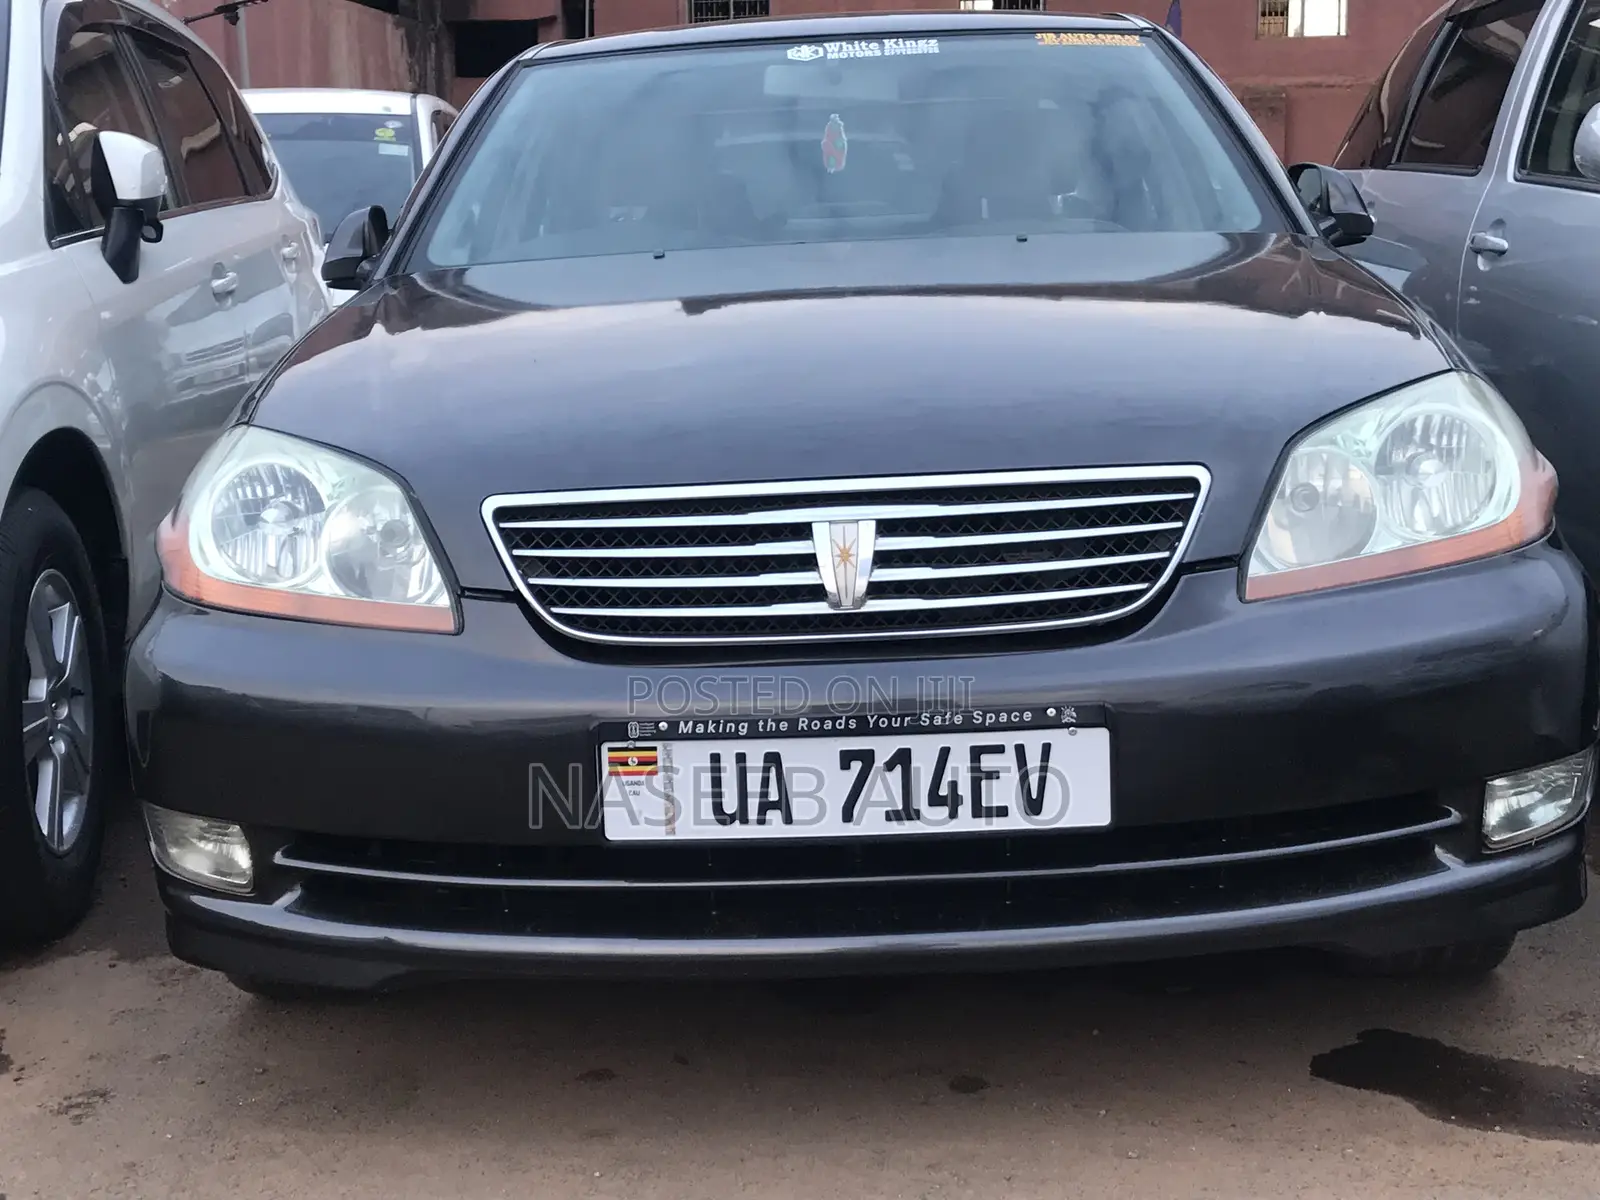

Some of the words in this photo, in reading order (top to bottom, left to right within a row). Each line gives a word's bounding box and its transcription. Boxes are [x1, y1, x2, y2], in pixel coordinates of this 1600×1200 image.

[823, 40, 880, 53] White
[883, 38, 939, 50] Kingz
[827, 50, 881, 59] MOTORS
[678, 720, 749, 736] Making
[758, 718, 789, 732] the
[797, 717, 857, 731] Roads
[867, 715, 911, 729] Your
[919, 712, 963, 727] Safe
[972, 710, 1033, 726] Space
[709, 751, 794, 826] UA
[839, 742, 1052, 823] 714EV
